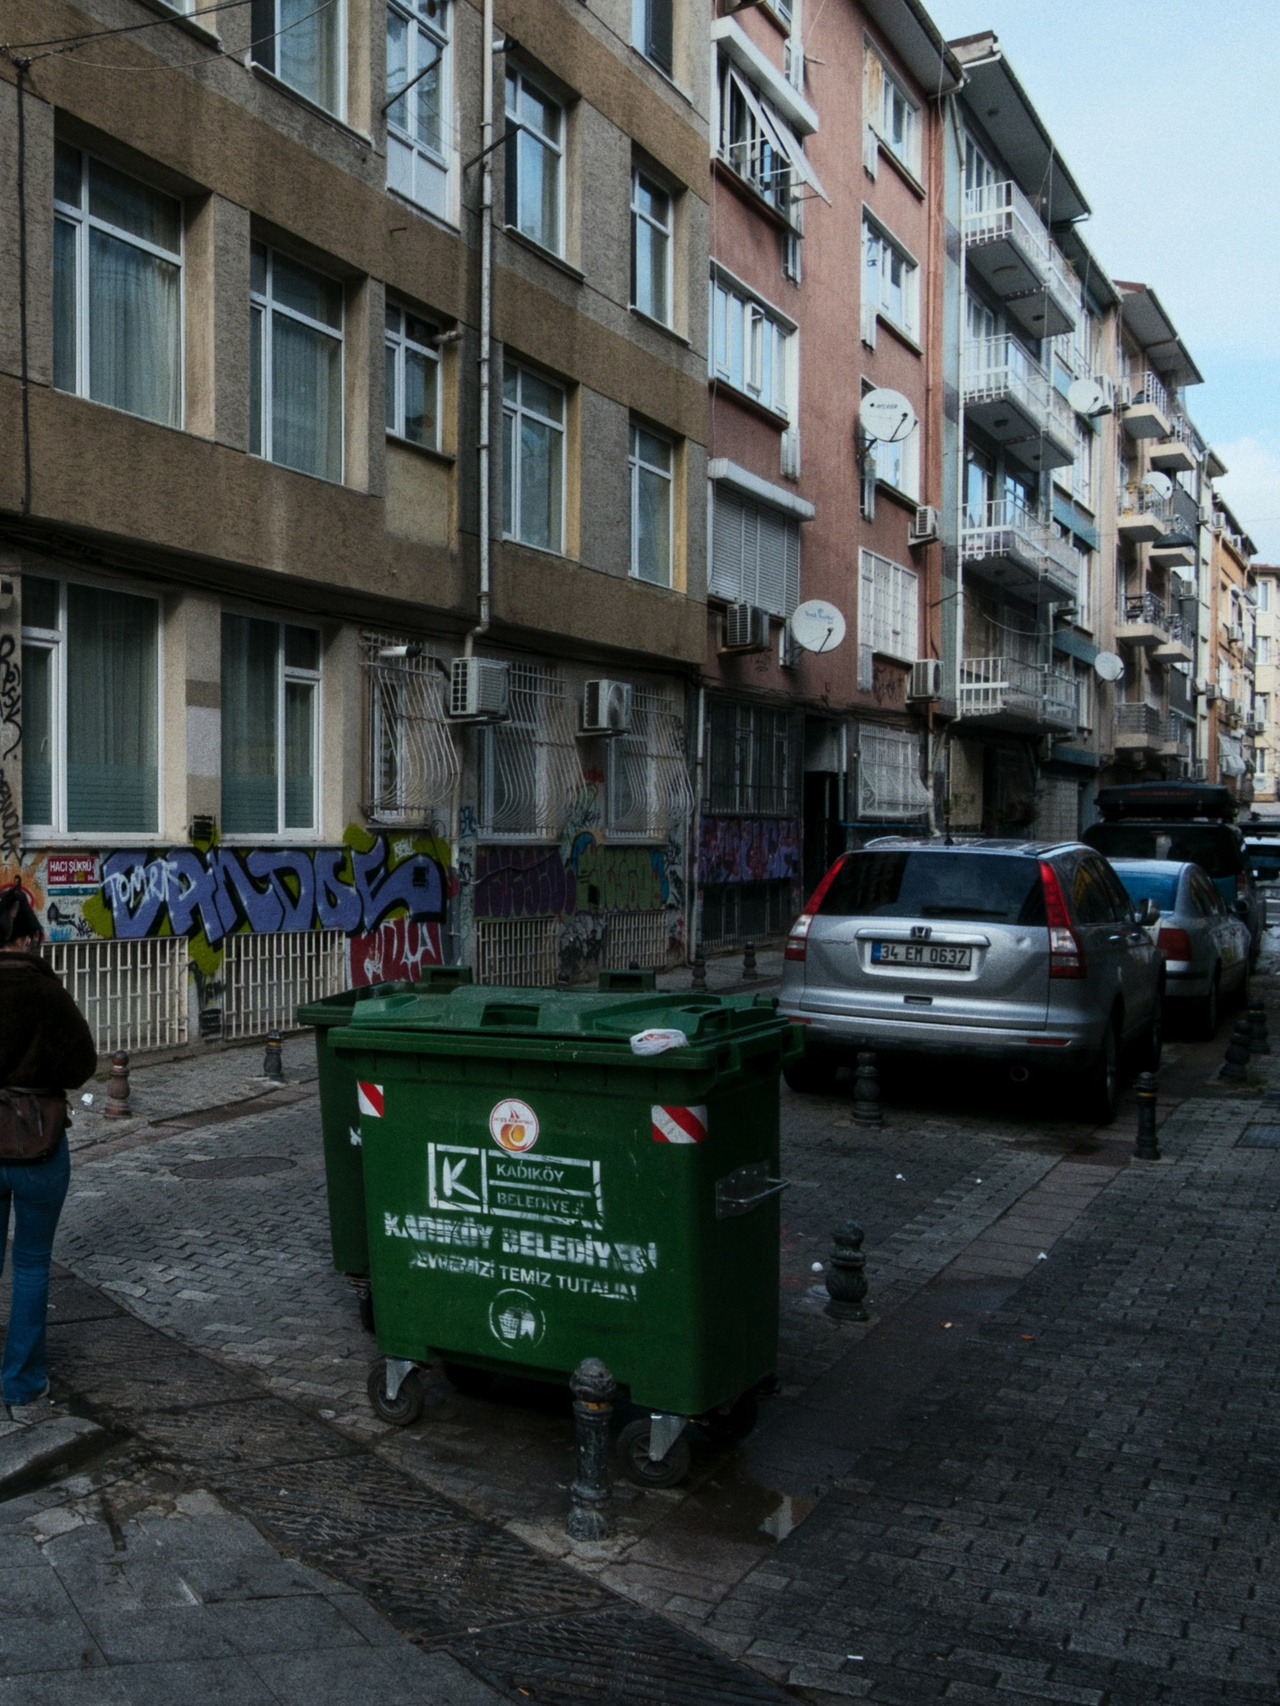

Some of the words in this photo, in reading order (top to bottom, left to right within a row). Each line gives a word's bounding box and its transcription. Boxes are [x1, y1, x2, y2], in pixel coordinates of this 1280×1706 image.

[49, 861, 68, 872] HACI
[69, 859, 92, 874] ŞÜKRÜ
[881, 945, 898, 959] 34
[905, 947, 923, 961] EM
[930, 948, 966, 964] 0637
[442, 1155, 480, 1202] K
[496, 1162, 565, 1183] KADIKÖY
[383, 1211, 494, 1250] KADIKÖY
[499, 1265, 552, 1289] TEMİZ
